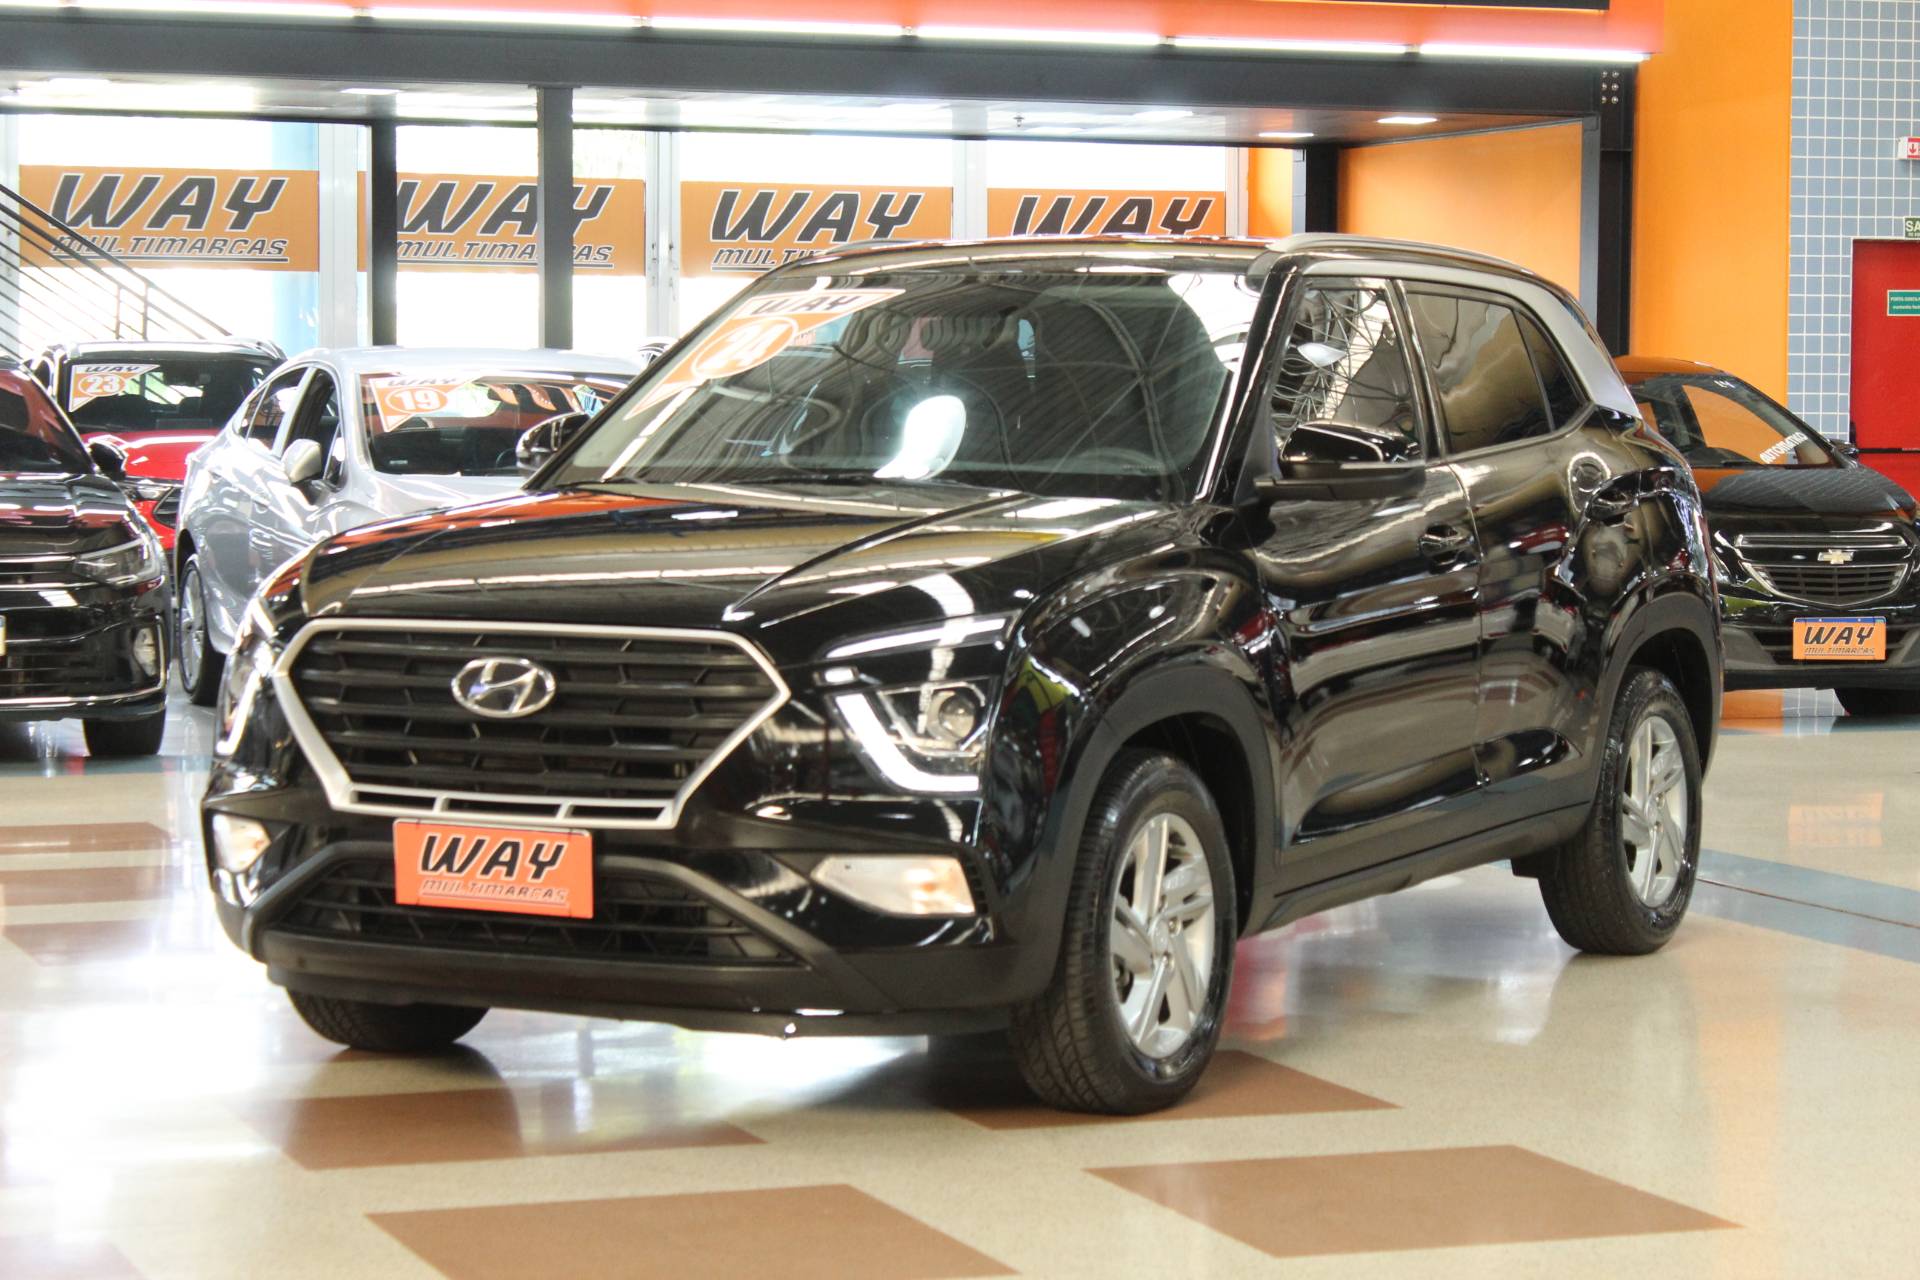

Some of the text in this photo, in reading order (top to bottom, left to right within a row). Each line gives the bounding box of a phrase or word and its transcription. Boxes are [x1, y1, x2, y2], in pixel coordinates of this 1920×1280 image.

[49, 173, 289, 232] WAY
[710, 189, 925, 244] WAY
[1011, 195, 1216, 236] WAY
[51, 235, 289, 256] MULTIMARCAS
[751, 295, 863, 314] WAY
[87, 374, 121, 393] 23
[394, 389, 441, 411] 19
[1804, 626, 1874, 645] WAY
[418, 832, 568, 883] WAY
